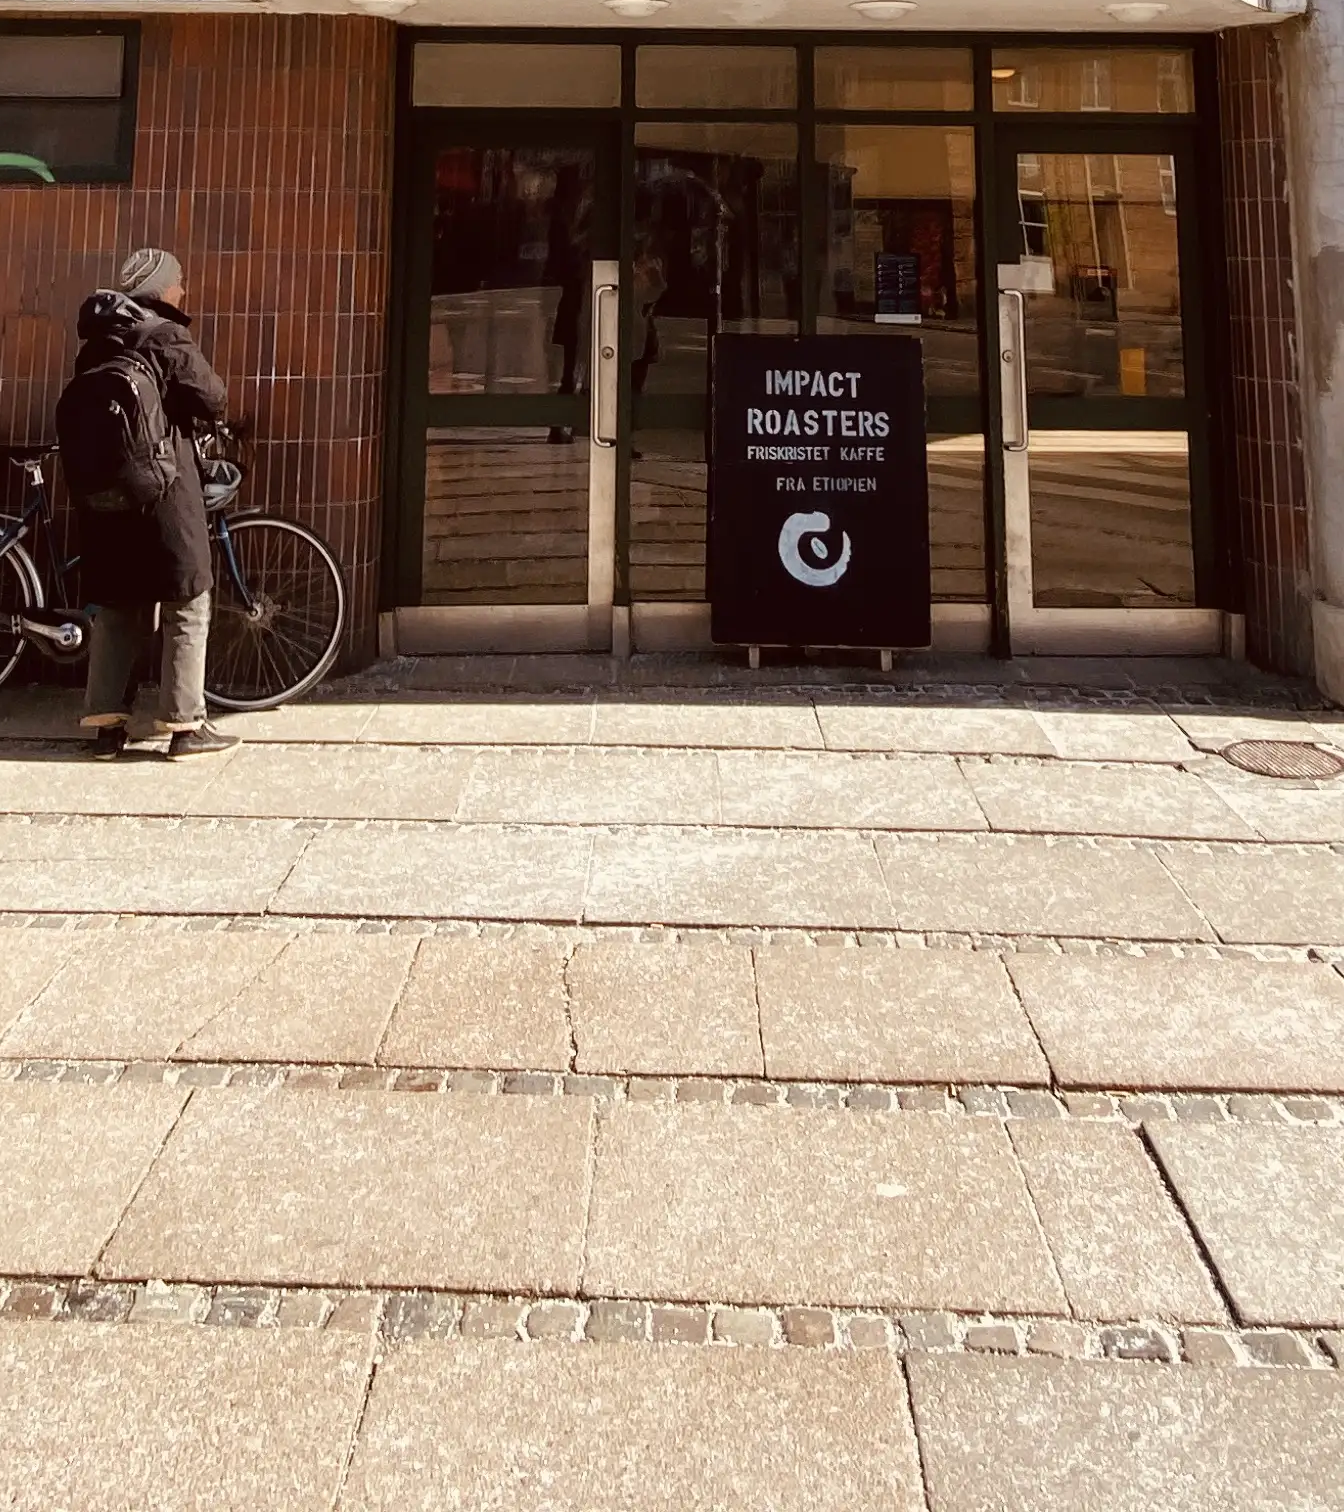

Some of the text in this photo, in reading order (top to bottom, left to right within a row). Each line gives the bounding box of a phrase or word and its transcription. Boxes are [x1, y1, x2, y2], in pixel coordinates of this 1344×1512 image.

[765, 369, 861, 398] IMPACT
[747, 407, 890, 437] ROASTERS
[747, 445, 885, 462] FRISKRISTET KAFFE
[776, 476, 877, 493] FRA ETIOPIEN
